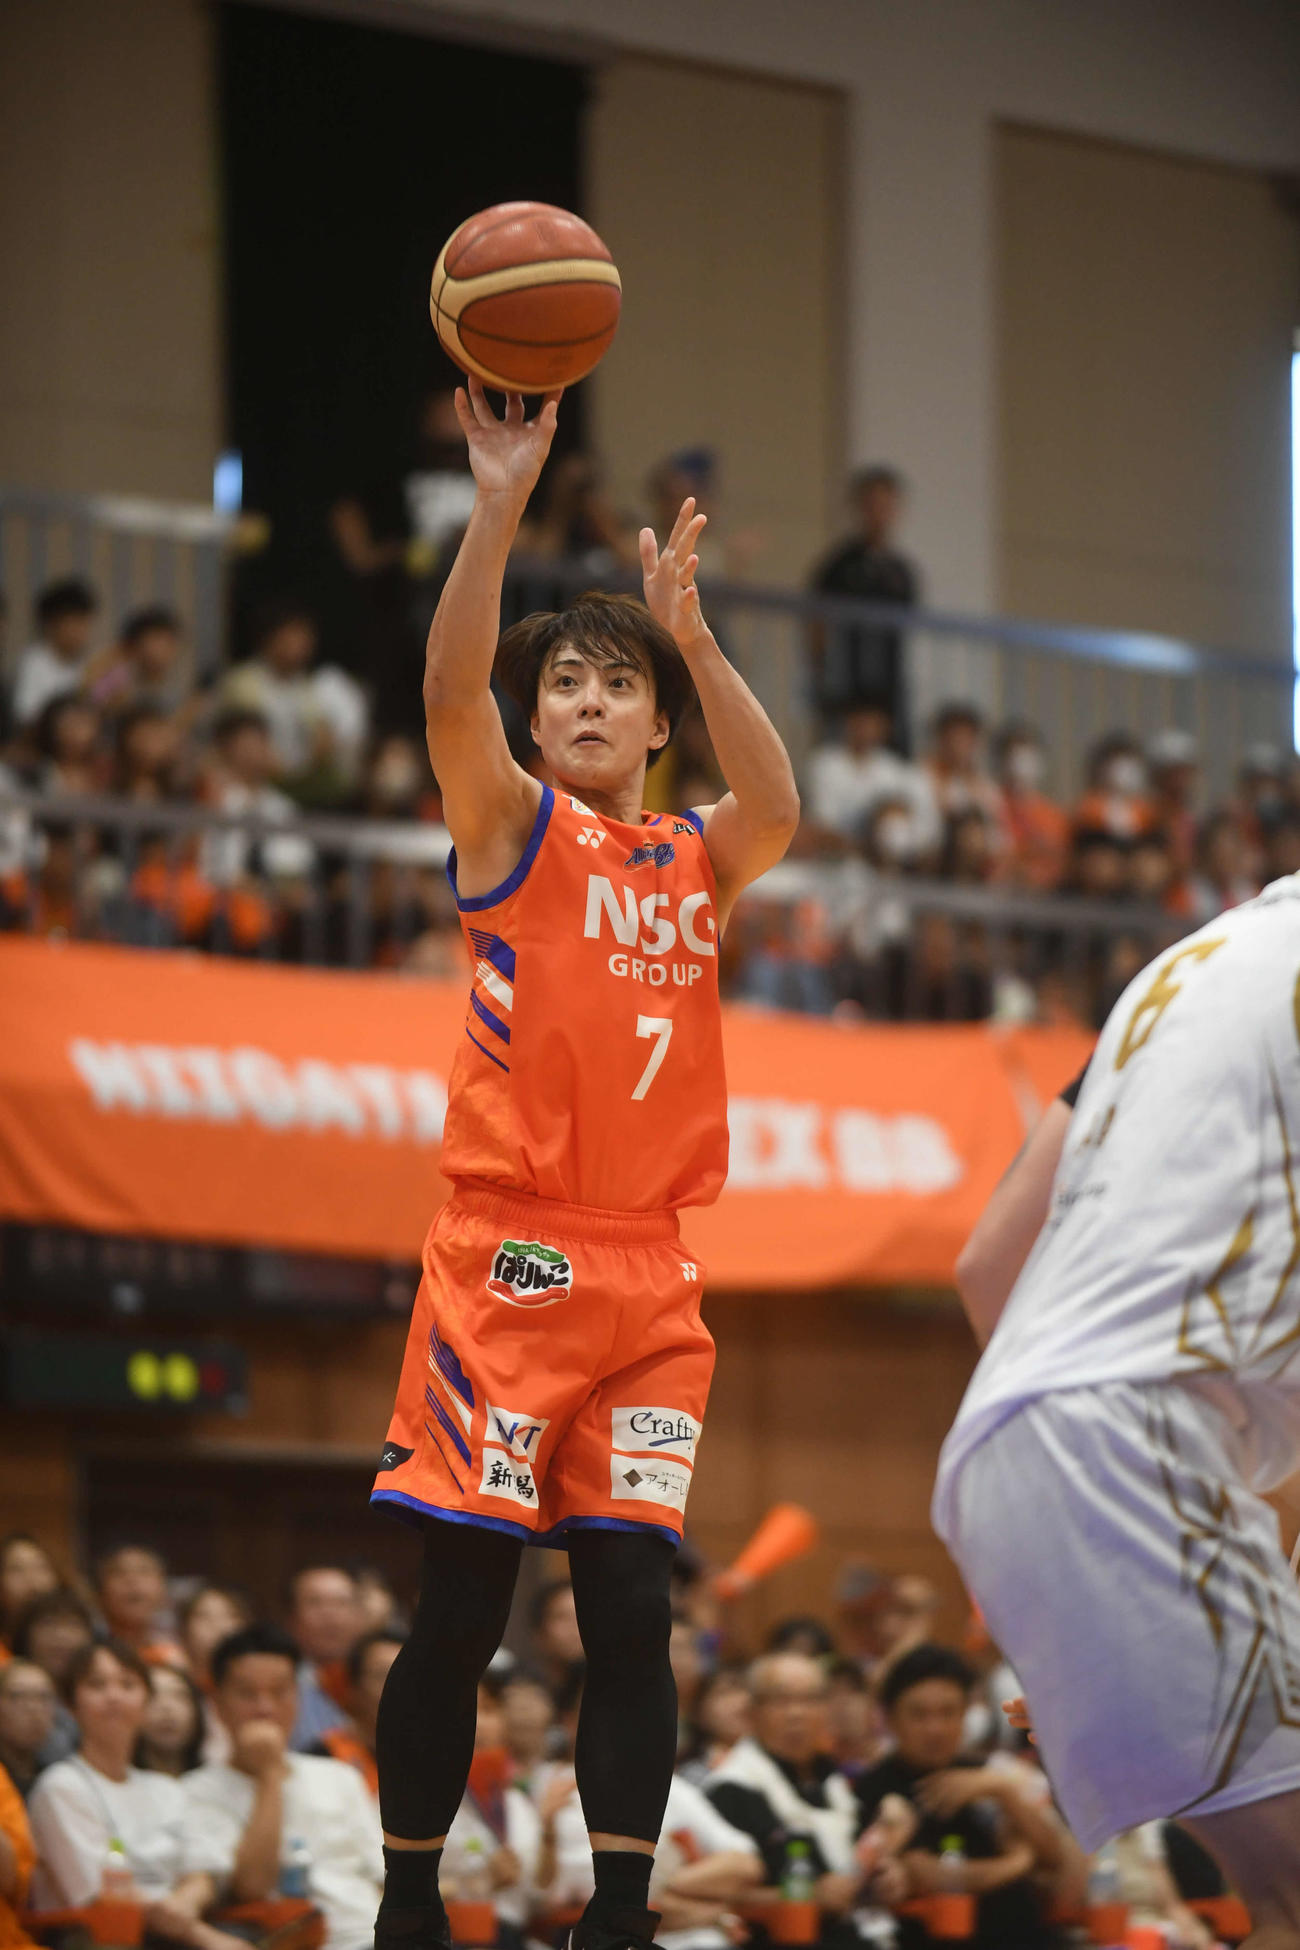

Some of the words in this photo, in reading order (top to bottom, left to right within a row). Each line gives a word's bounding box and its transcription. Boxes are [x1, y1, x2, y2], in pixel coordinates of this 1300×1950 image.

[583, 873, 715, 957] NSG
[607, 953, 703, 987] GROUP
[630, 1014, 673, 1101] 7
[493, 1251, 570, 1290] ぱりんこ
